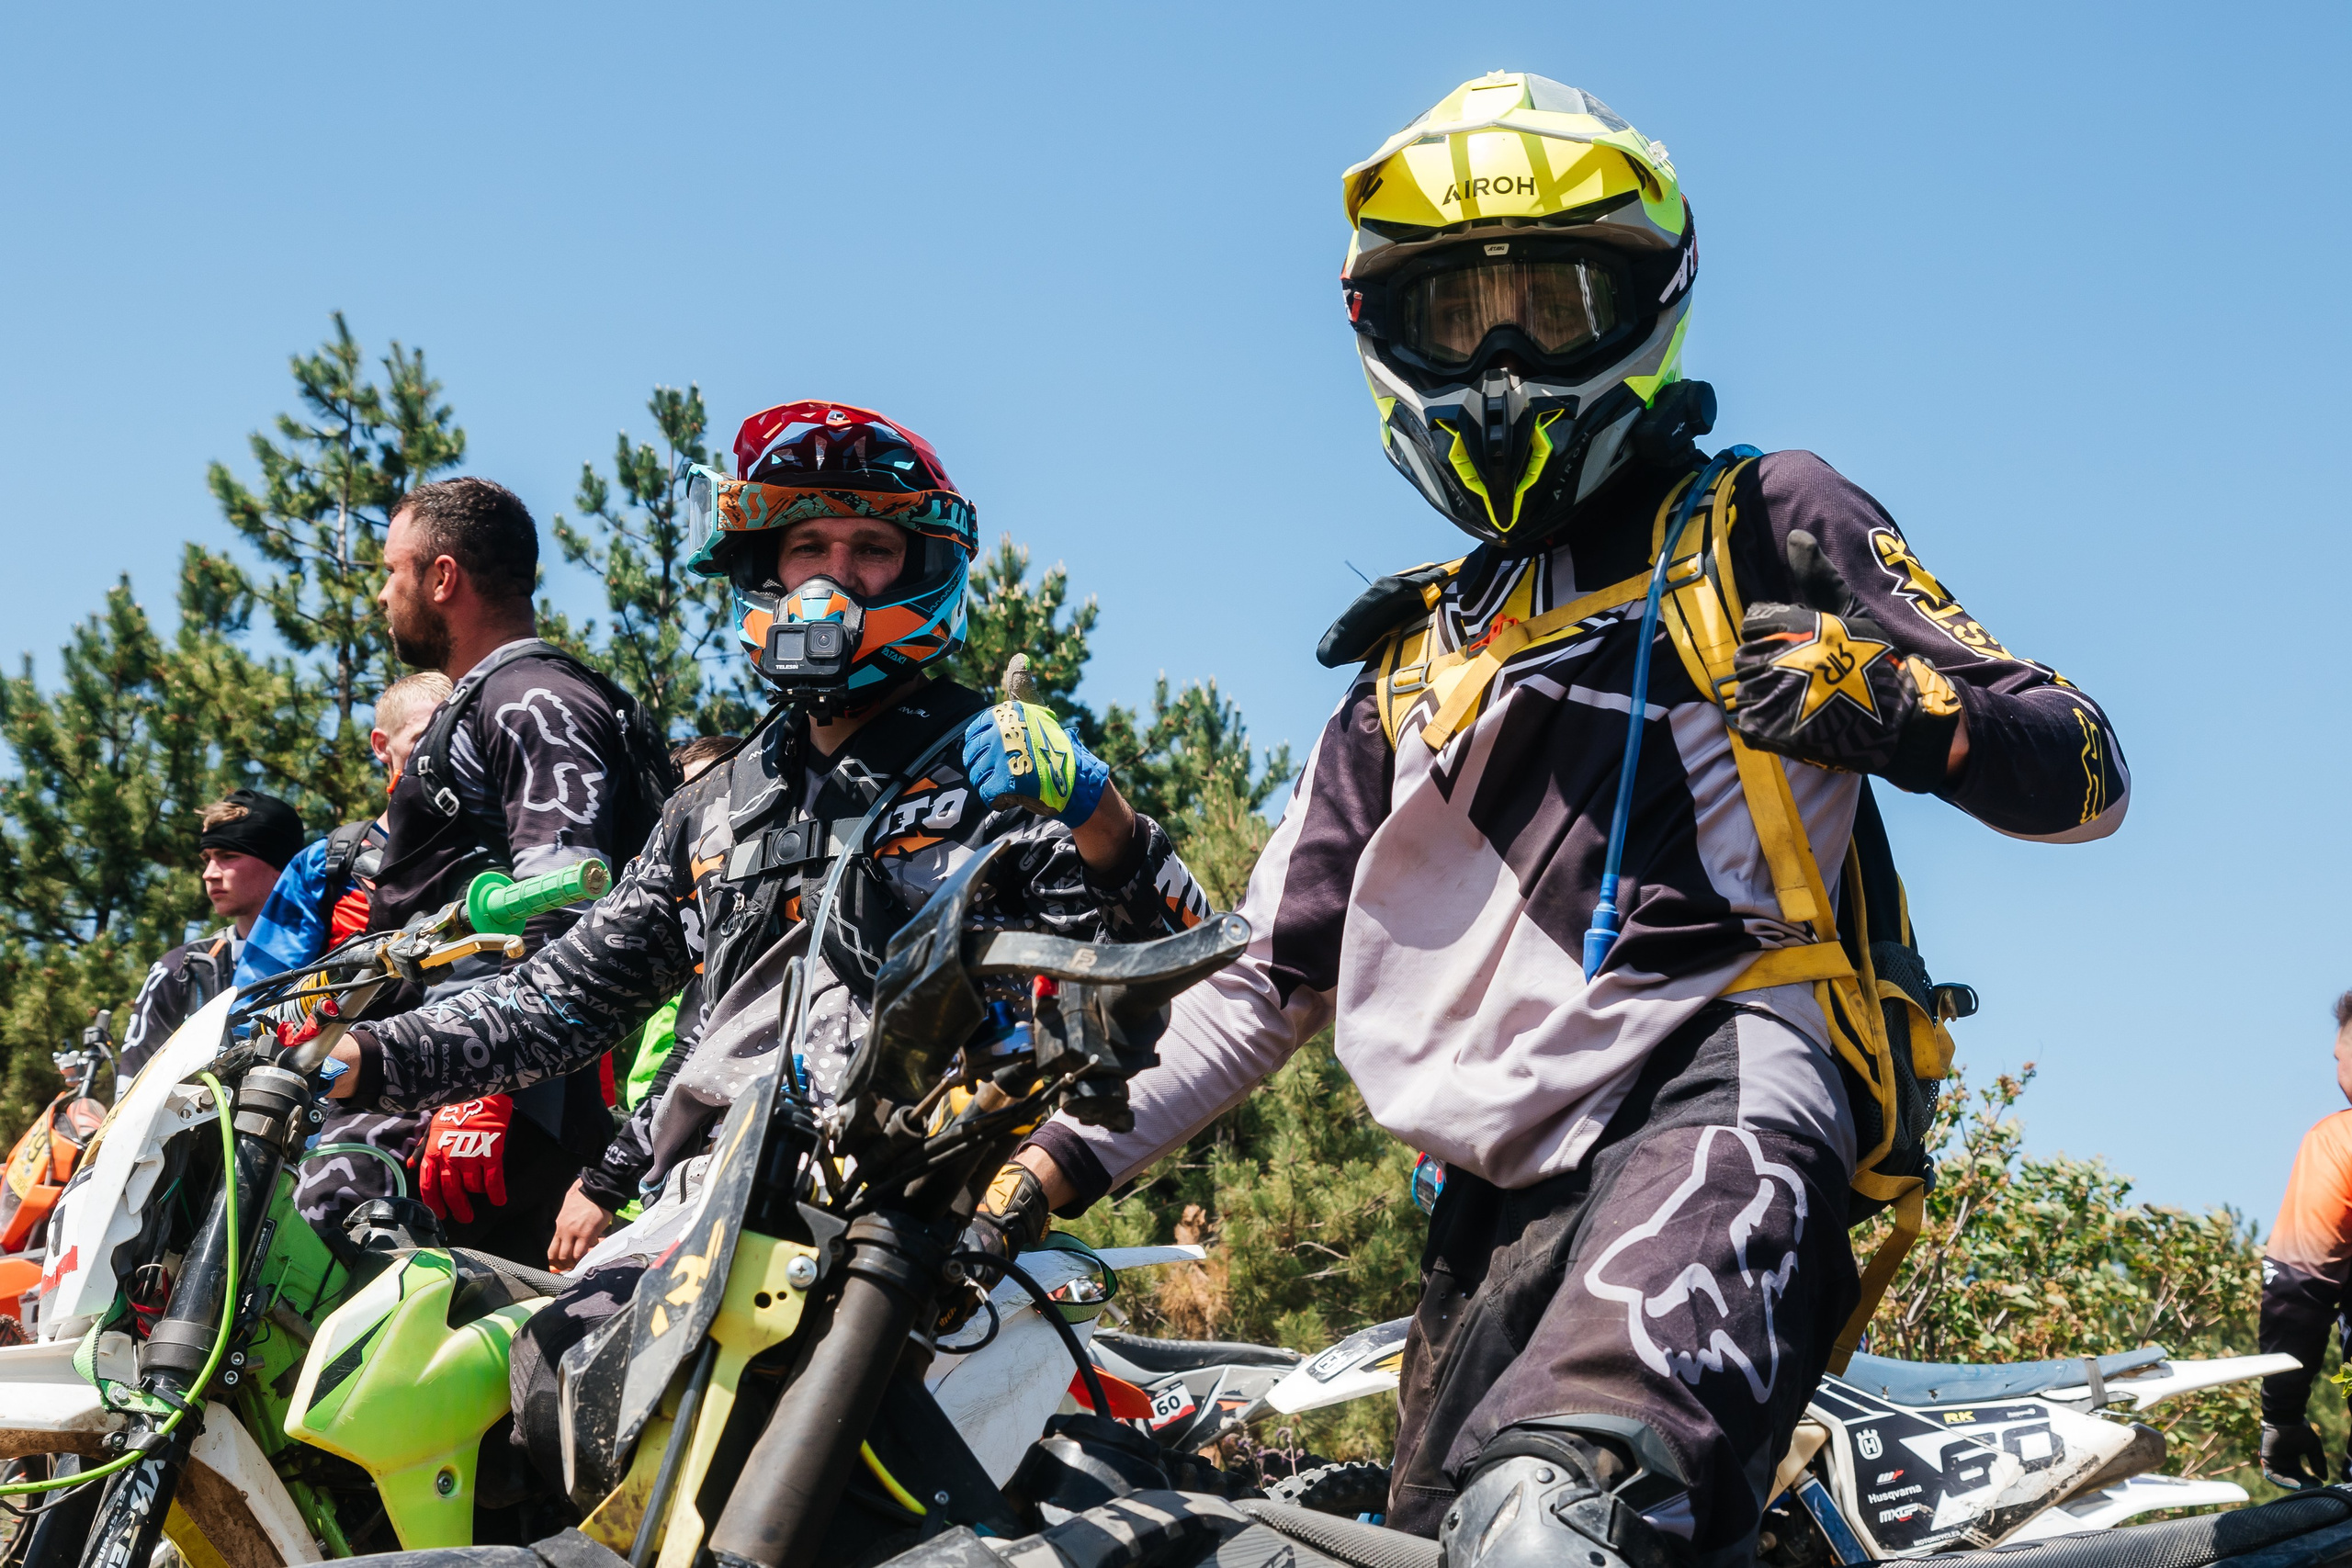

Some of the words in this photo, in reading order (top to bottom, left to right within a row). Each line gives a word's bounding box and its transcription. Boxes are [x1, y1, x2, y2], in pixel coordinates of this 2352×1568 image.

[1442, 176, 1534, 206] AIROH
[604, 933, 648, 952] GR
[419, 1034, 435, 1078] GR
[441, 1043, 451, 1085] ATAKI
[437, 1130, 502, 1158] FOX
[1157, 1394, 1181, 1416] 60
[1943, 1410, 1975, 1424] RK
[1868, 1483, 1923, 1505] Husqvarna
[1879, 1502, 1923, 1523] MXGP
